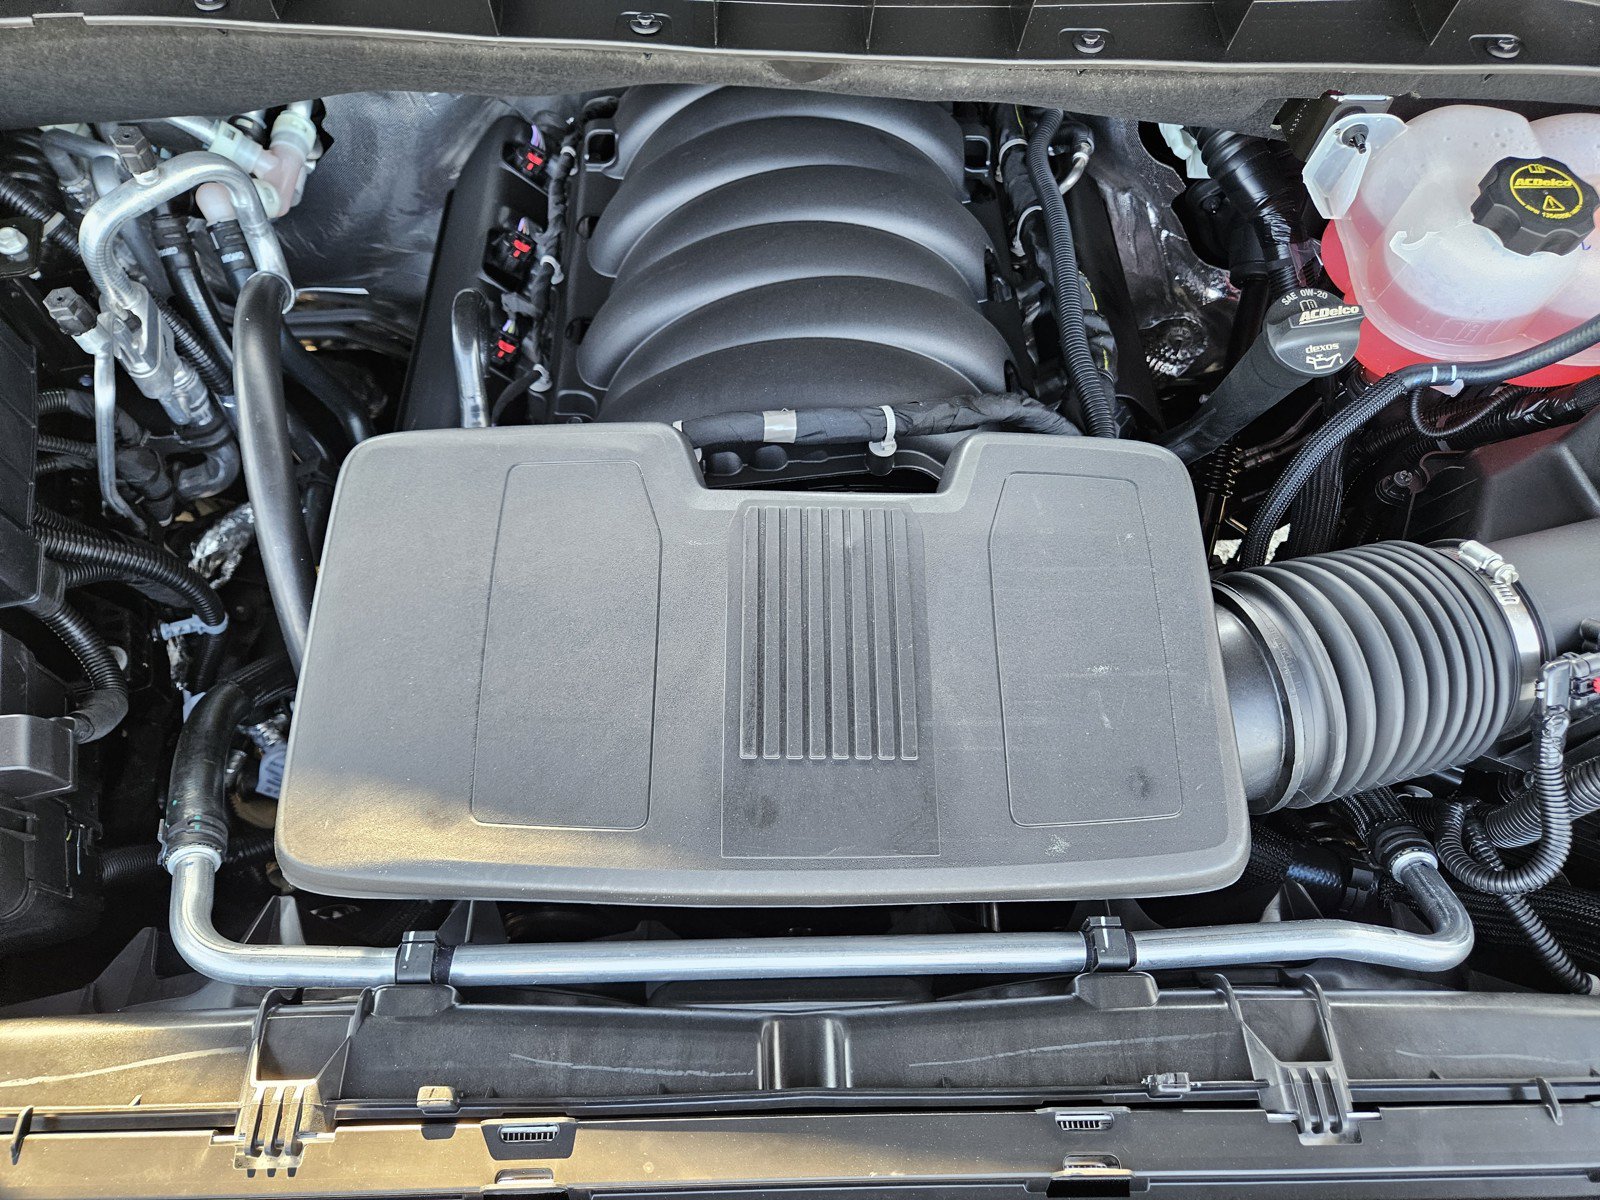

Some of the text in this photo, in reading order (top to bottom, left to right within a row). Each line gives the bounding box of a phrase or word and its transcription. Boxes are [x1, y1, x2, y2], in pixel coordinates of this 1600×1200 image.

[1514, 178, 1573, 187] ACDelco
[1281, 288, 1328, 306] SAE 0W-20
[1299, 305, 1360, 322] ACDelco
[1305, 342, 1339, 354] dexos
